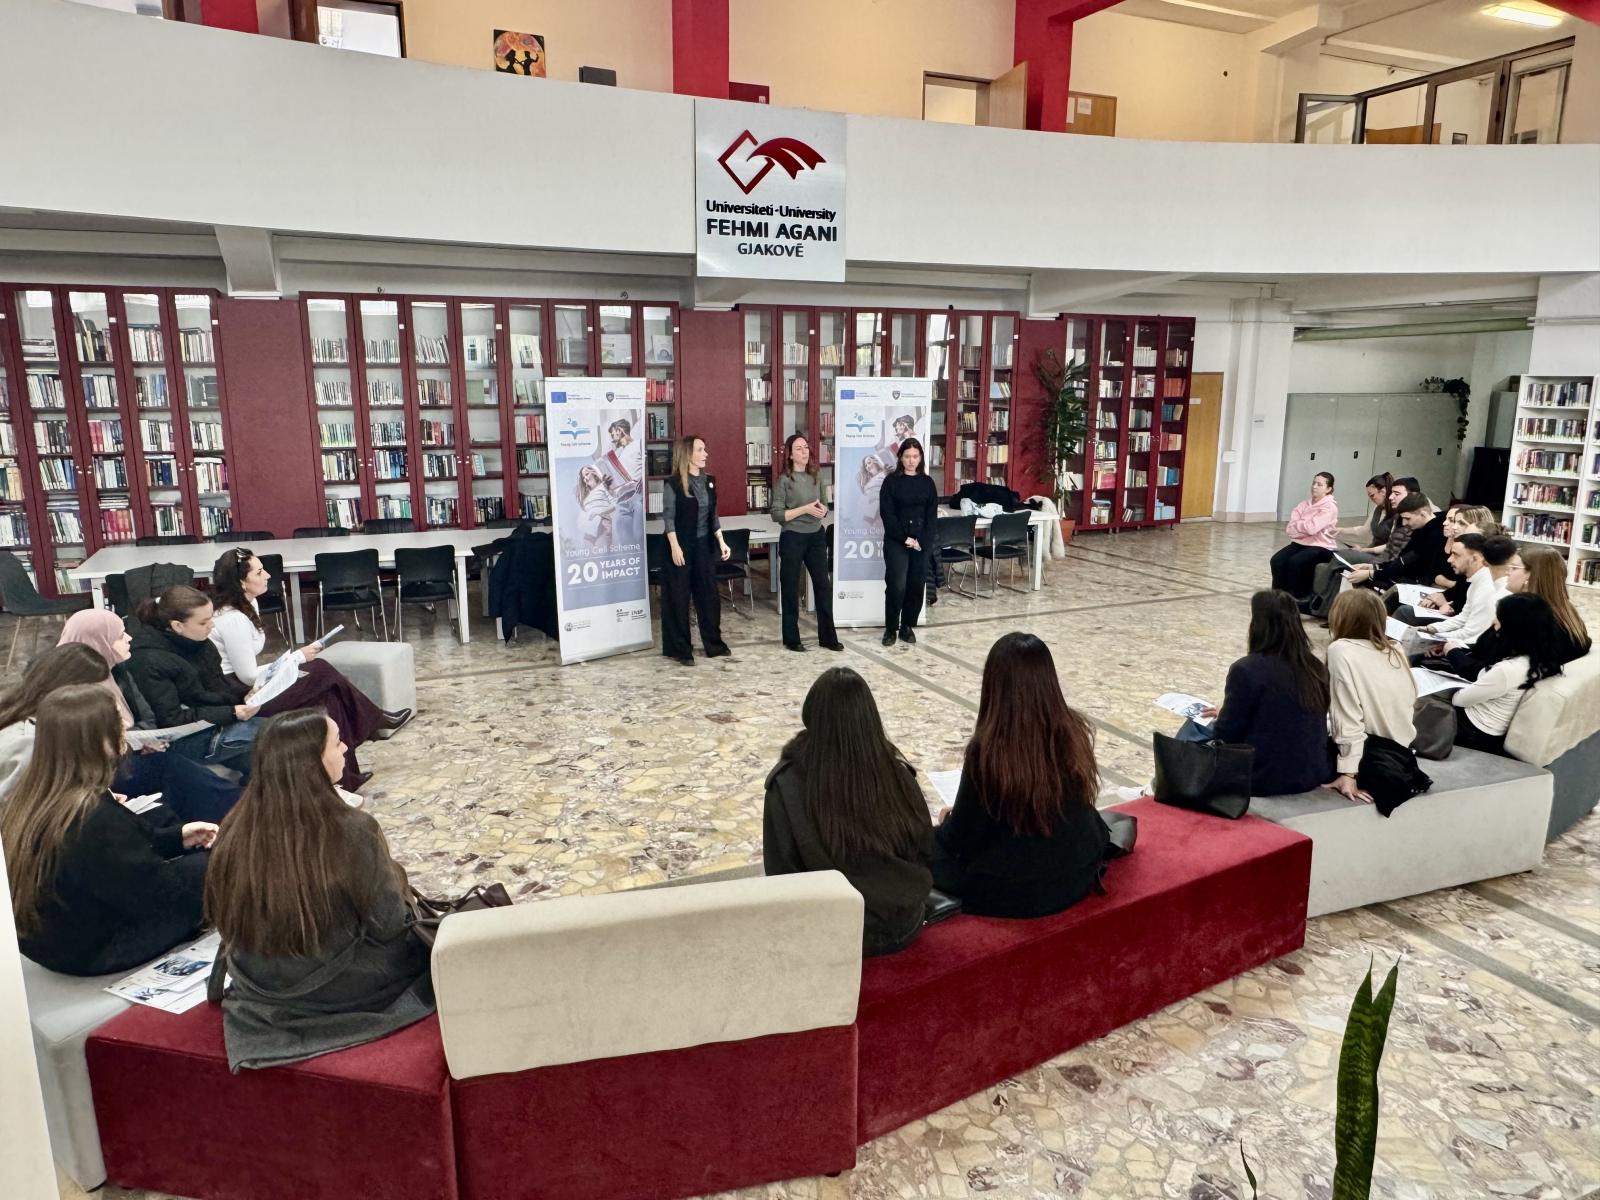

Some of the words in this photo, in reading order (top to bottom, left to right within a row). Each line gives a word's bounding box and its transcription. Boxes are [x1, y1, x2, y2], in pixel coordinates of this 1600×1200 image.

[706, 218, 769, 238] FEHMI
[775, 223, 837, 242] AGANI
[737, 242, 804, 258] GJAKOVË
[565, 547, 590, 557] Young
[609, 543, 641, 552] Scheme
[843, 540, 875, 559] 20
[567, 561, 599, 585] 20
[600, 558, 627, 568] YEARS
[628, 557, 641, 565] OF
[601, 566, 641, 579] IMPACT
